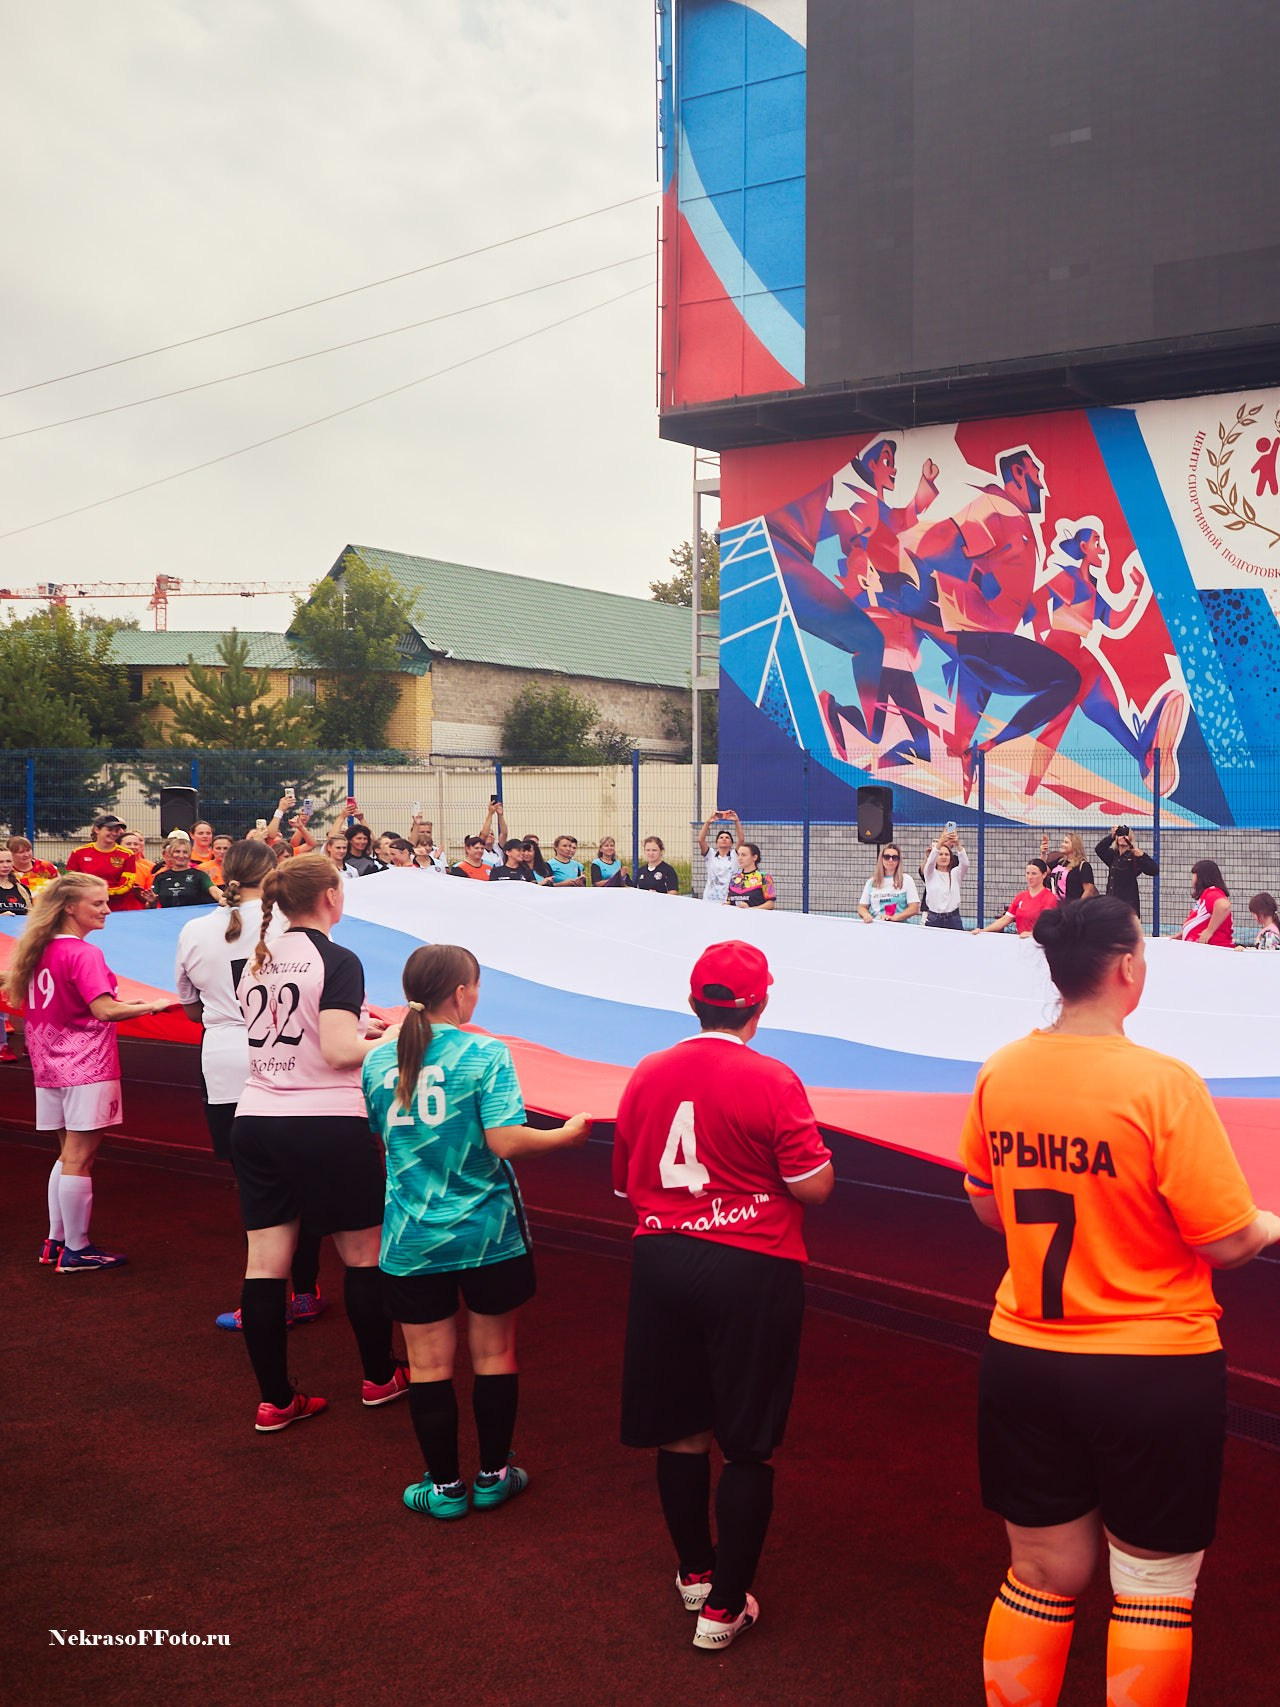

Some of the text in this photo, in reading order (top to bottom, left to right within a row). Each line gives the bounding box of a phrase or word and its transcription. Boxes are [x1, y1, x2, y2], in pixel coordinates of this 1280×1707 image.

[1189, 430, 1207, 472] ЦЕНТР
[1187, 474, 1224, 550] СПОРТИВНОЙ
[28, 967, 55, 1010] 19
[246, 982, 305, 1048] 22
[251, 1056, 296, 1076] Ковров
[382, 1064, 447, 1127] 26
[659, 1100, 711, 1198] 4
[988, 1130, 1117, 1178] БРЫНЗА
[1013, 1188, 1076, 1320] 7
